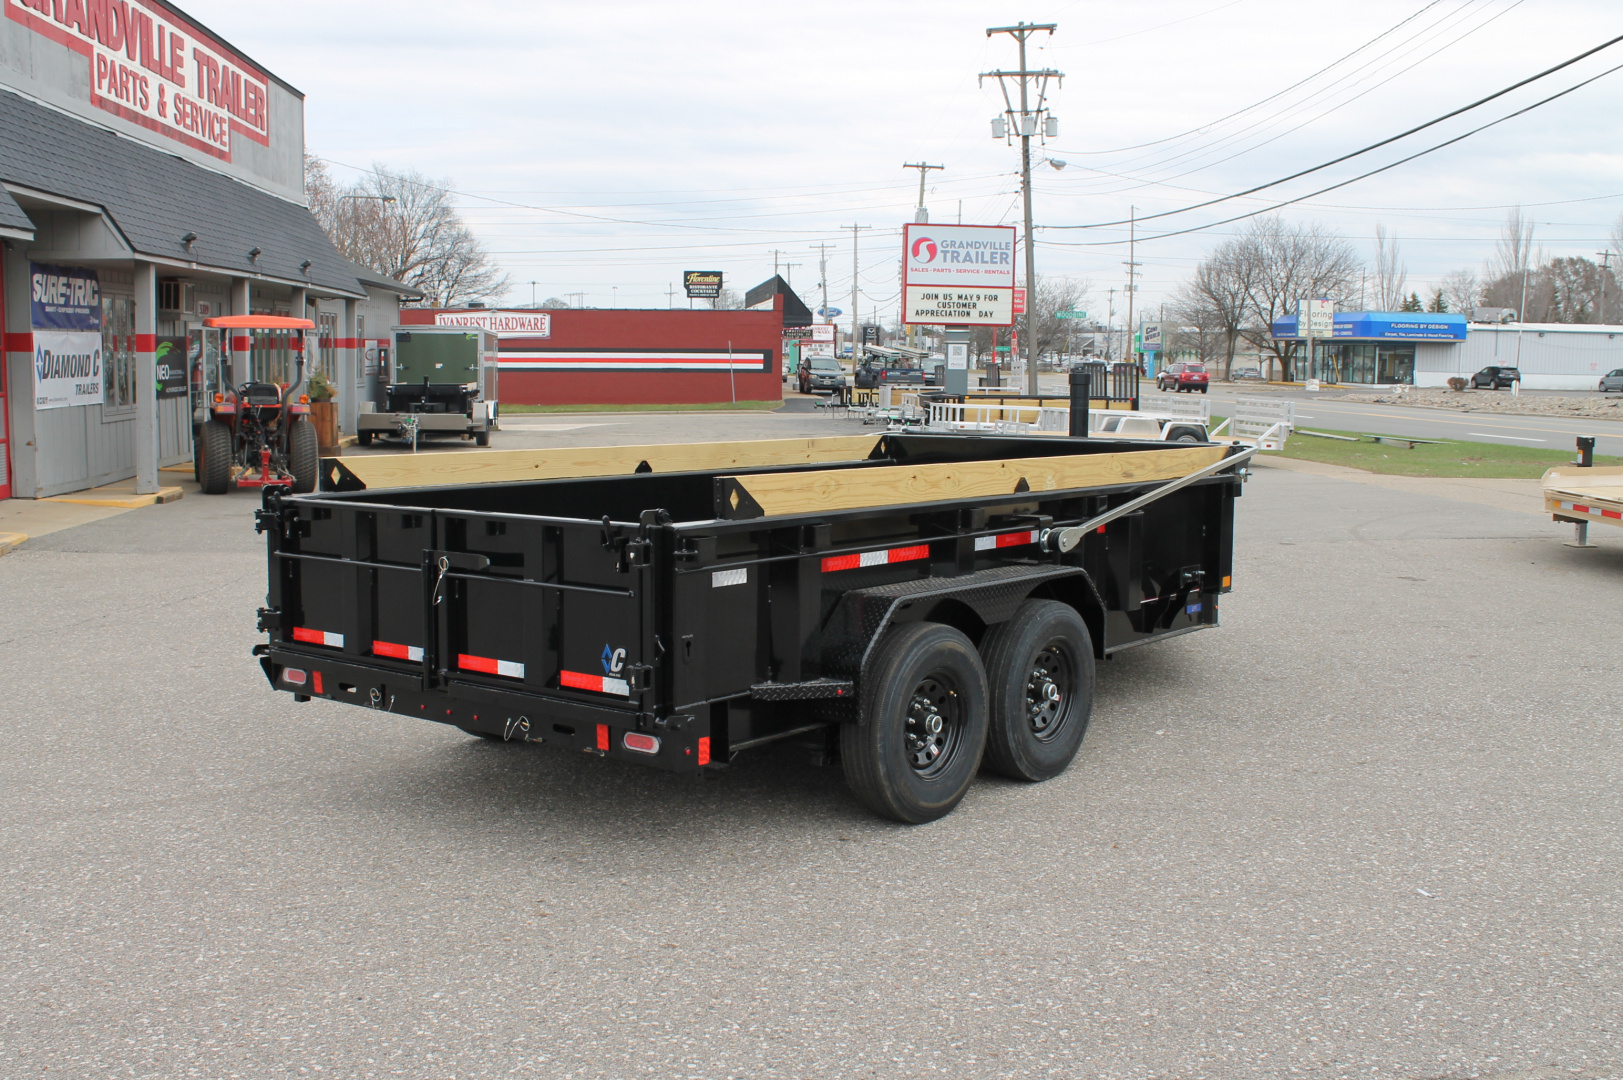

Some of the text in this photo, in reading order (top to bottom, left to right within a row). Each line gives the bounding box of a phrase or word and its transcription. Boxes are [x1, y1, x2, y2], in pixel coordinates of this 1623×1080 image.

[20, 0, 266, 132] ANDVILLE TRAILER
[97, 53, 228, 148] PARTS & SERVICE
[940, 240, 1011, 251] GRANDVILLE
[940, 250, 1010, 265] TRAILER
[686, 272, 720, 285] Florentine
[32, 273, 98, 306] SURE-TRAC
[921, 293, 939, 301] JOIN
[943, 293, 953, 301] US
[957, 293, 974, 301] MAY
[937, 301, 977, 309] CUSTOMER
[915, 309, 994, 318] APPRECIATION DAY
[1300, 310, 1332, 320] Floring
[490, 317, 546, 330] HARDWARE
[1299, 320, 1306, 328] by
[42, 349, 99, 379] DIAMOND C
[156, 364, 170, 380] NEO
[75, 383, 99, 396] TRAILERS
[610, 648, 626, 672] C
